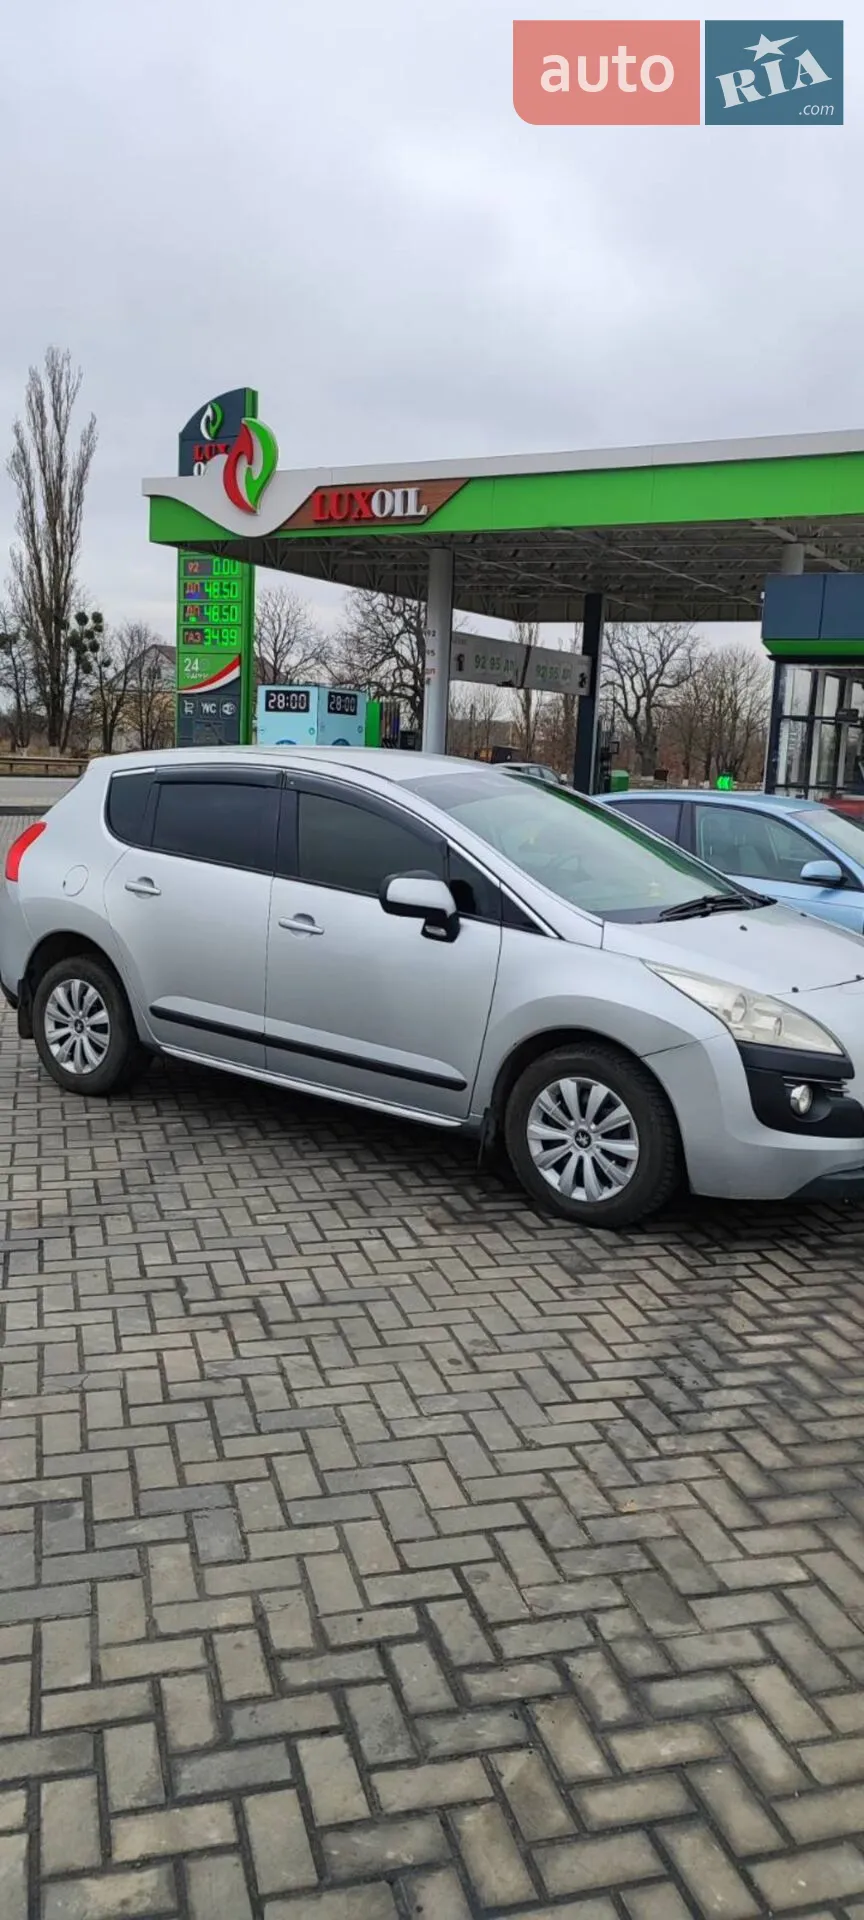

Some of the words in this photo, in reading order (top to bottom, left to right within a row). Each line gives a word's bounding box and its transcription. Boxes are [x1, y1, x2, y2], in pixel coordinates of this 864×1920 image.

[312, 487, 428, 521] LUXOIL
[184, 657, 199, 672] 24
[201, 702, 217, 714] WC
[268, 693, 307, 710] 28:00
[329, 694, 356, 713] 28:00
